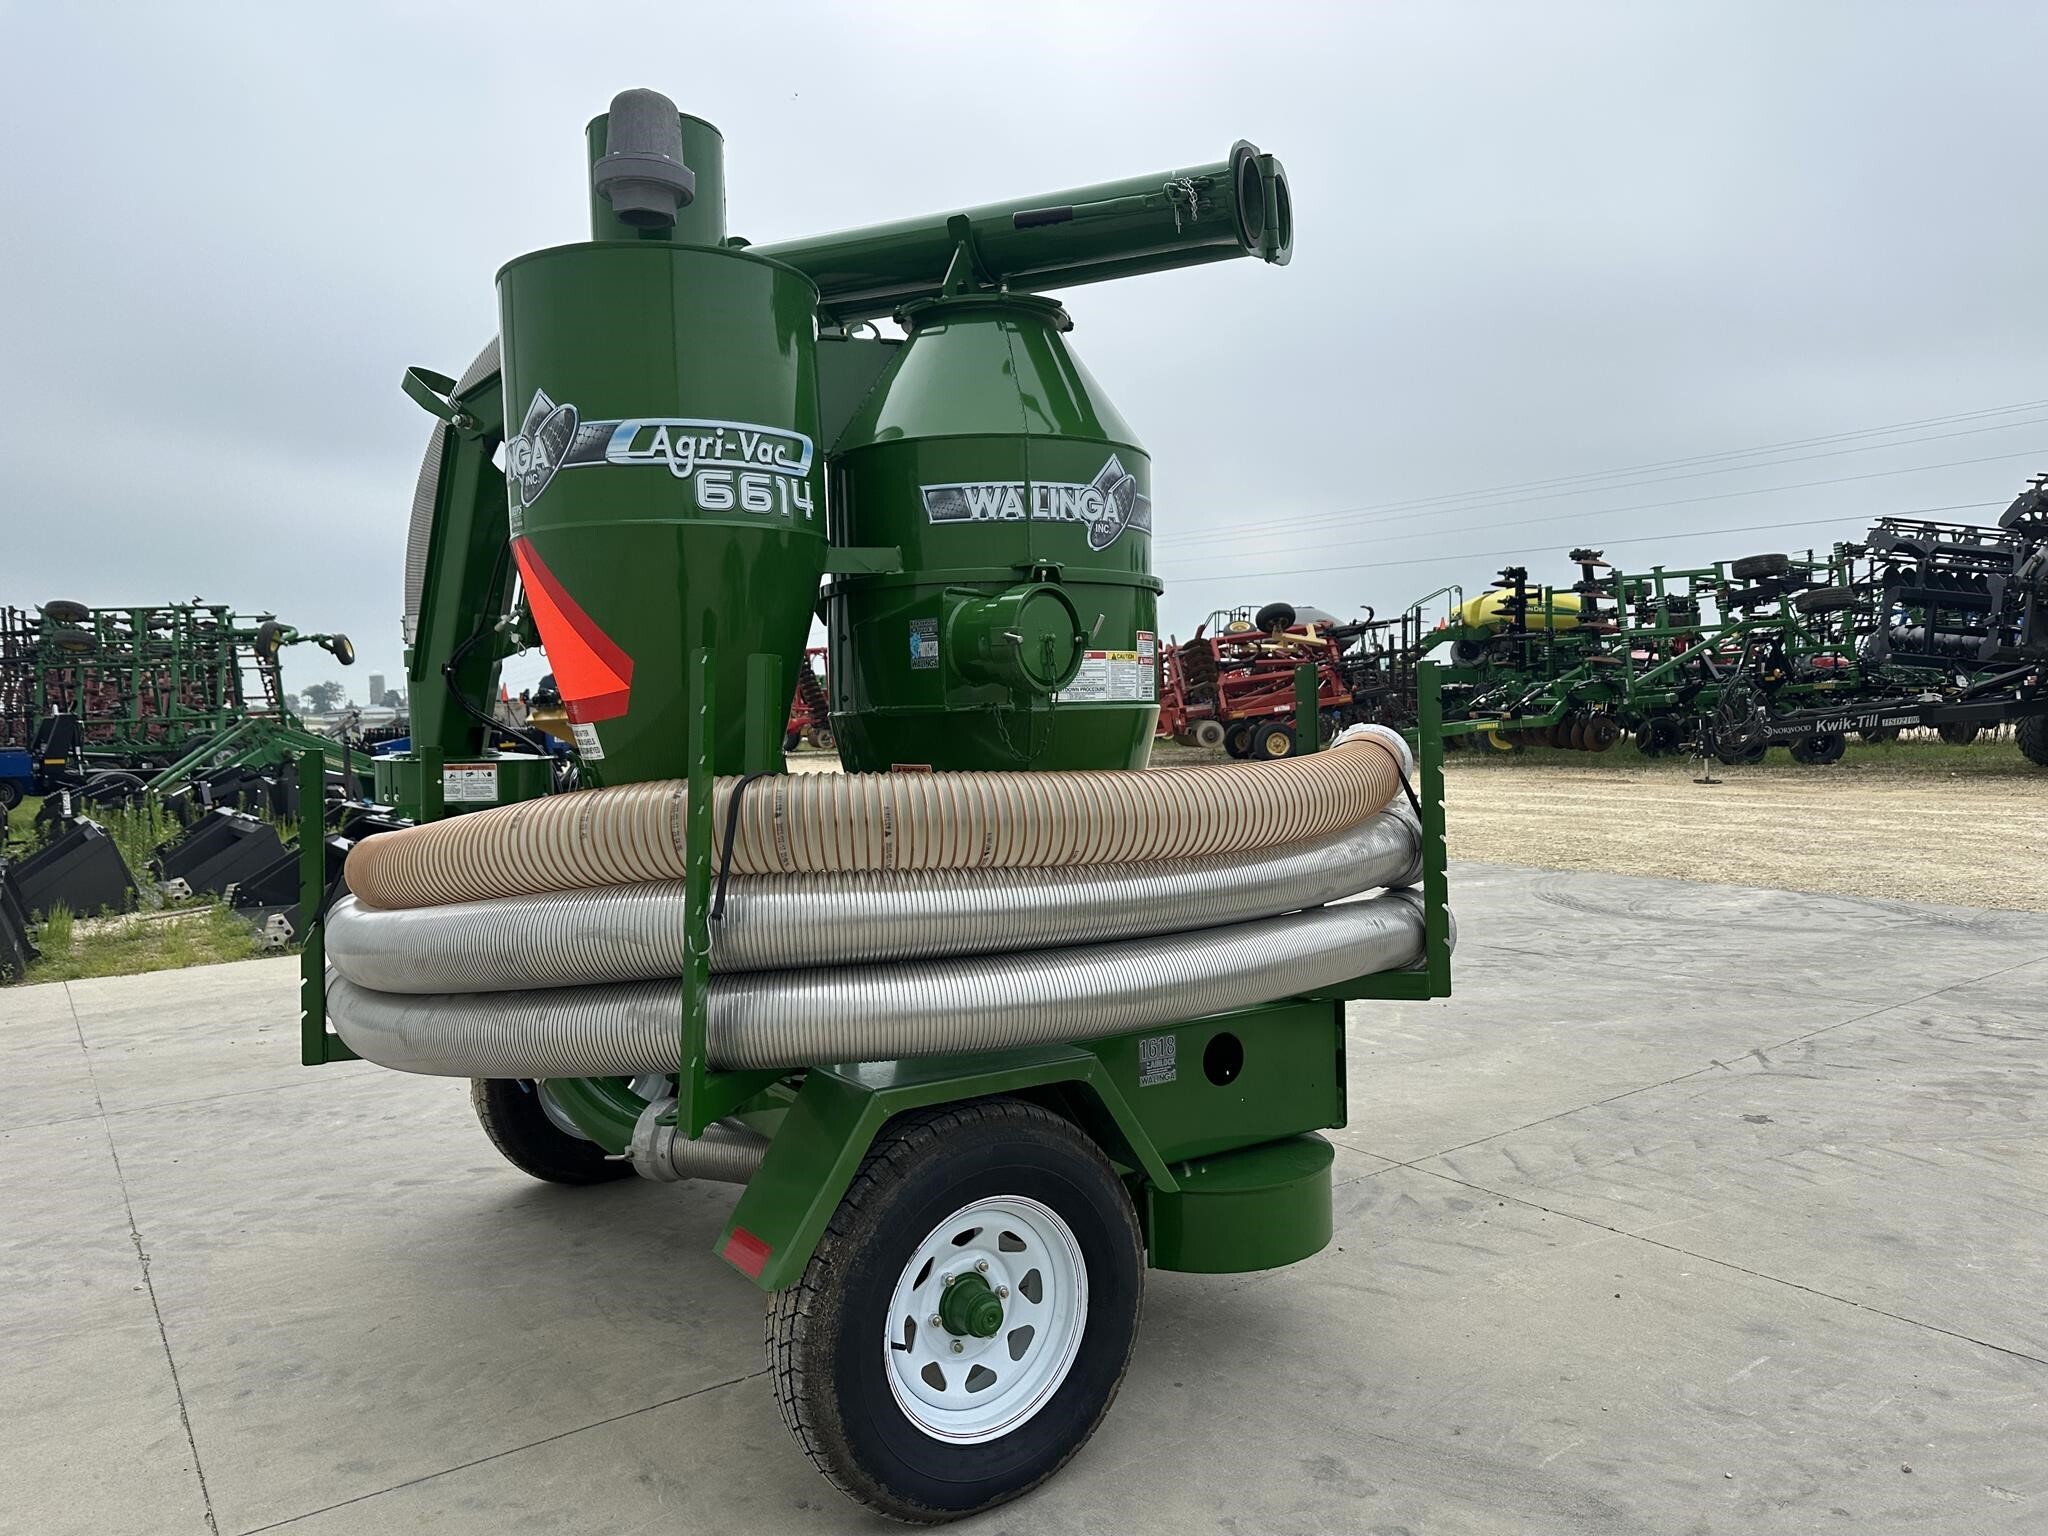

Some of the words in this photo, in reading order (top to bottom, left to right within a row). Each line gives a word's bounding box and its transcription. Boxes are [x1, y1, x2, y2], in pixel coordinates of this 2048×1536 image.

[649, 425, 787, 478] Agri-Vac
[695, 469, 814, 520] 6614
[964, 485, 1120, 523] WALINGA
[1095, 523, 1112, 535] INC.
[1772, 724, 1812, 735] NORWOOD
[1816, 714, 1879, 733] Kwik-Till
[1139, 1035, 1176, 1060] 1618
[1141, 1071, 1176, 1086] WALINGA
